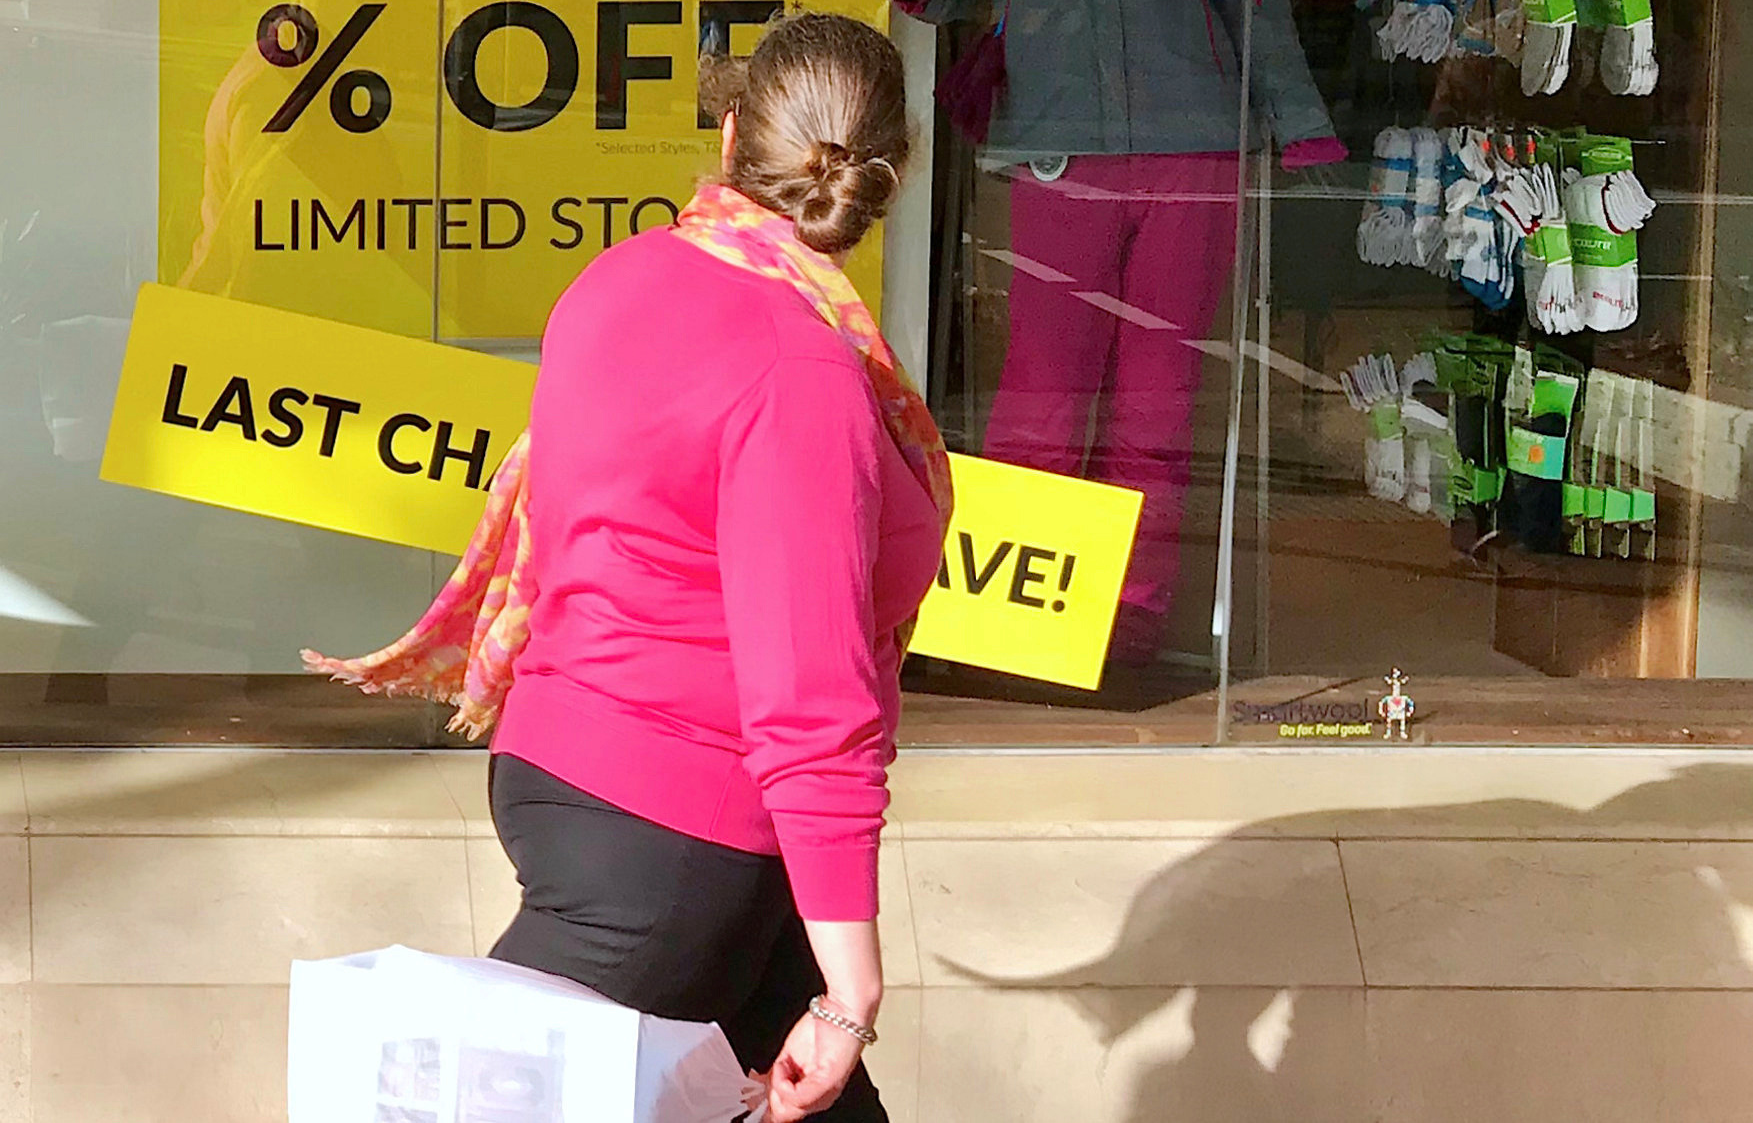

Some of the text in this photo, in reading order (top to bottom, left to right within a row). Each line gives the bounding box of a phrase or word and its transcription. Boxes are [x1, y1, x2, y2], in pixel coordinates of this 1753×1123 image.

[256, 2, 392, 134] %
[254, 196, 679, 251] LIMITED STO
[161, 363, 361, 458] LAST
[937, 531, 1077, 613] VE!
[1279, 724, 1296, 736] Go
[1315, 723, 1339, 735] Feel
